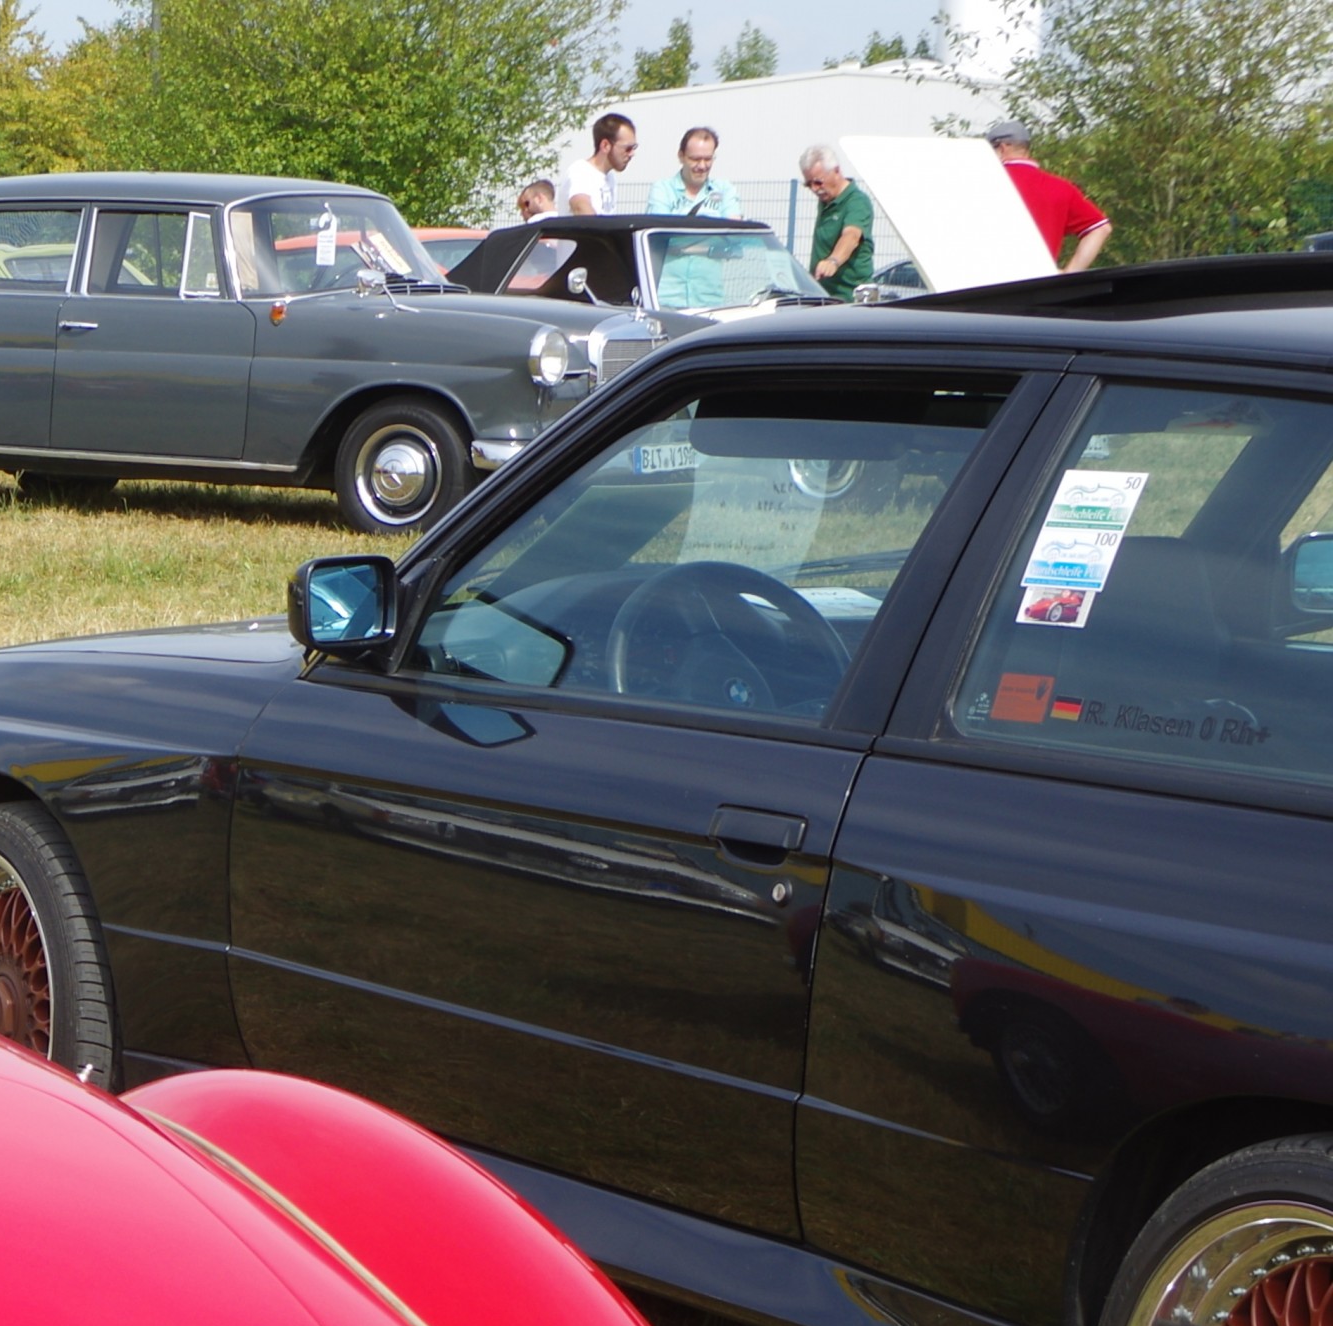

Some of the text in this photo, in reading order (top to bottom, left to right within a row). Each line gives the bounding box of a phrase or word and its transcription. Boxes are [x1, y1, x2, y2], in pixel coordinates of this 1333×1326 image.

[642, 448, 662, 469] BIT
[1123, 476, 1143, 491] 50
[1094, 532, 1119, 547] 100
[1114, 704, 1193, 737] Klasen
